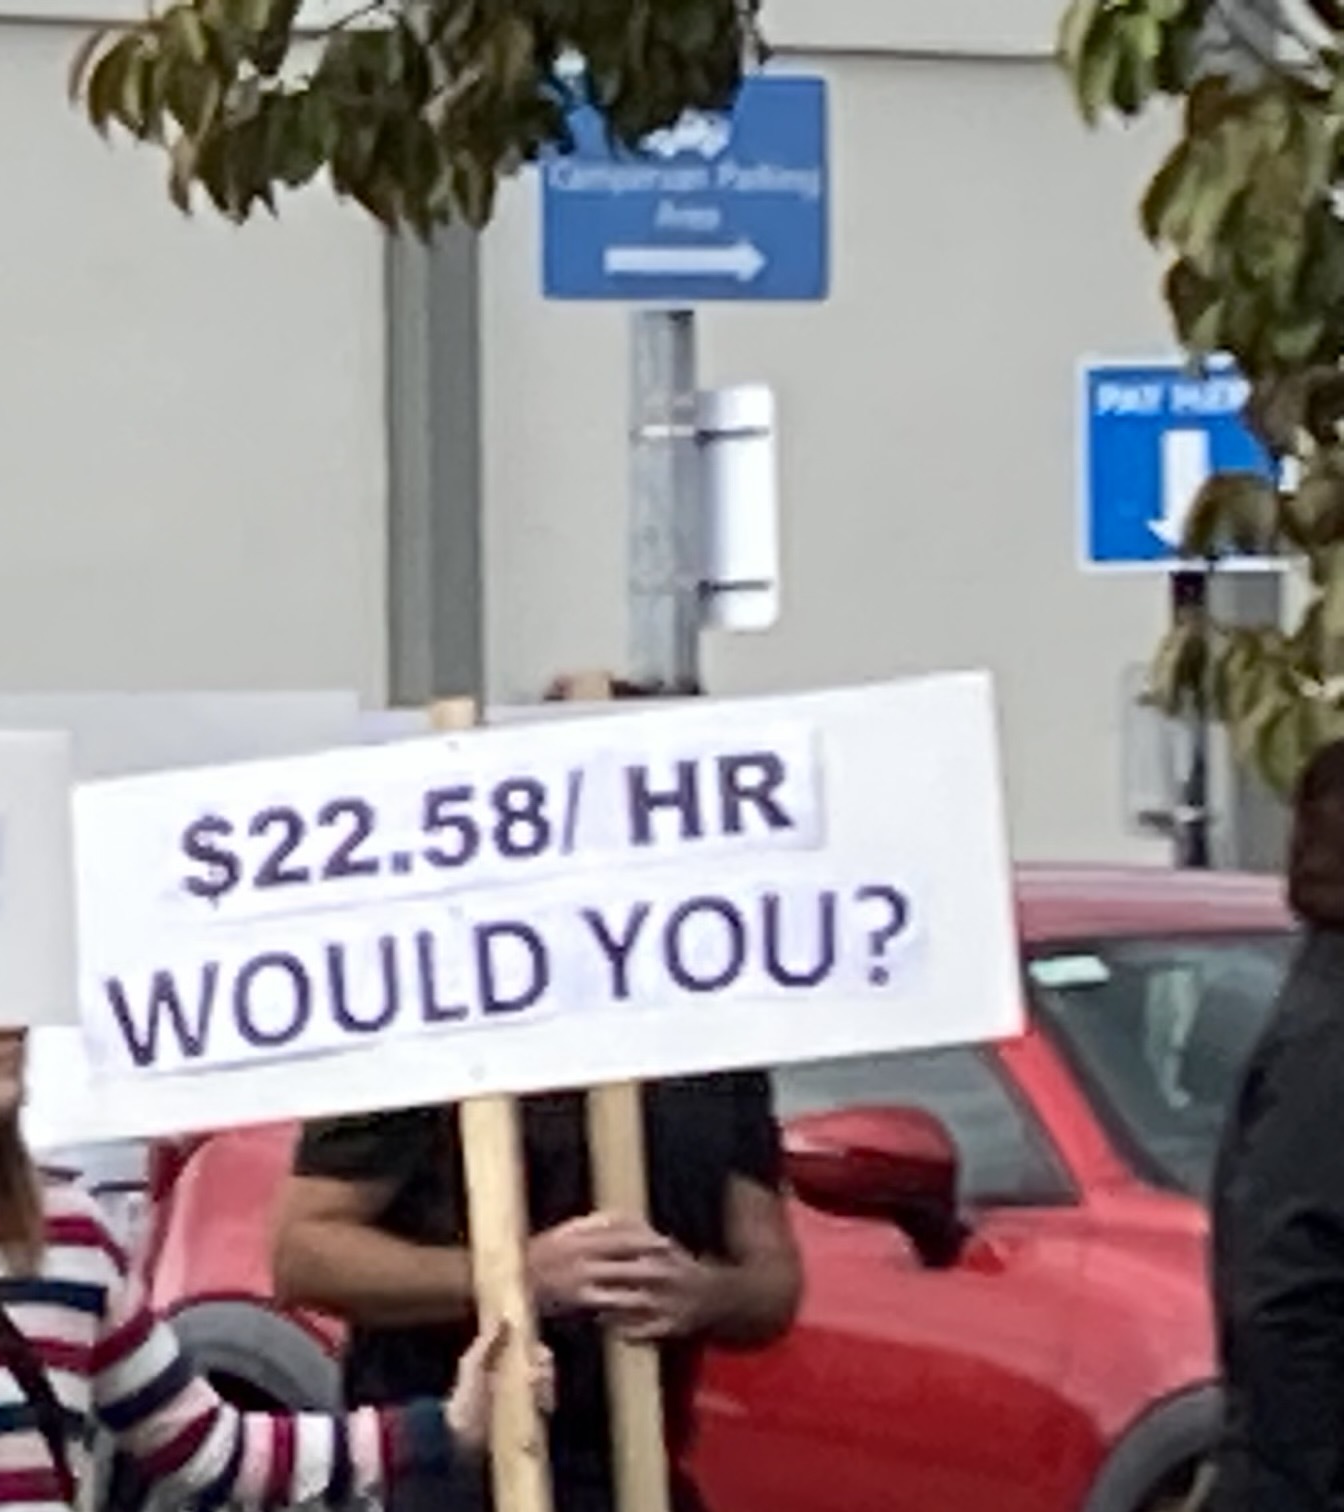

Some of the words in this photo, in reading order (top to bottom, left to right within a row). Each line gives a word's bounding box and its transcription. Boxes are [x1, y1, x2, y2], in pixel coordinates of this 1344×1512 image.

[180, 769, 583, 907] $22.58/
[628, 750, 794, 845] HR
[105, 923, 549, 1067] WOULD
[580, 884, 911, 999] YOU?
